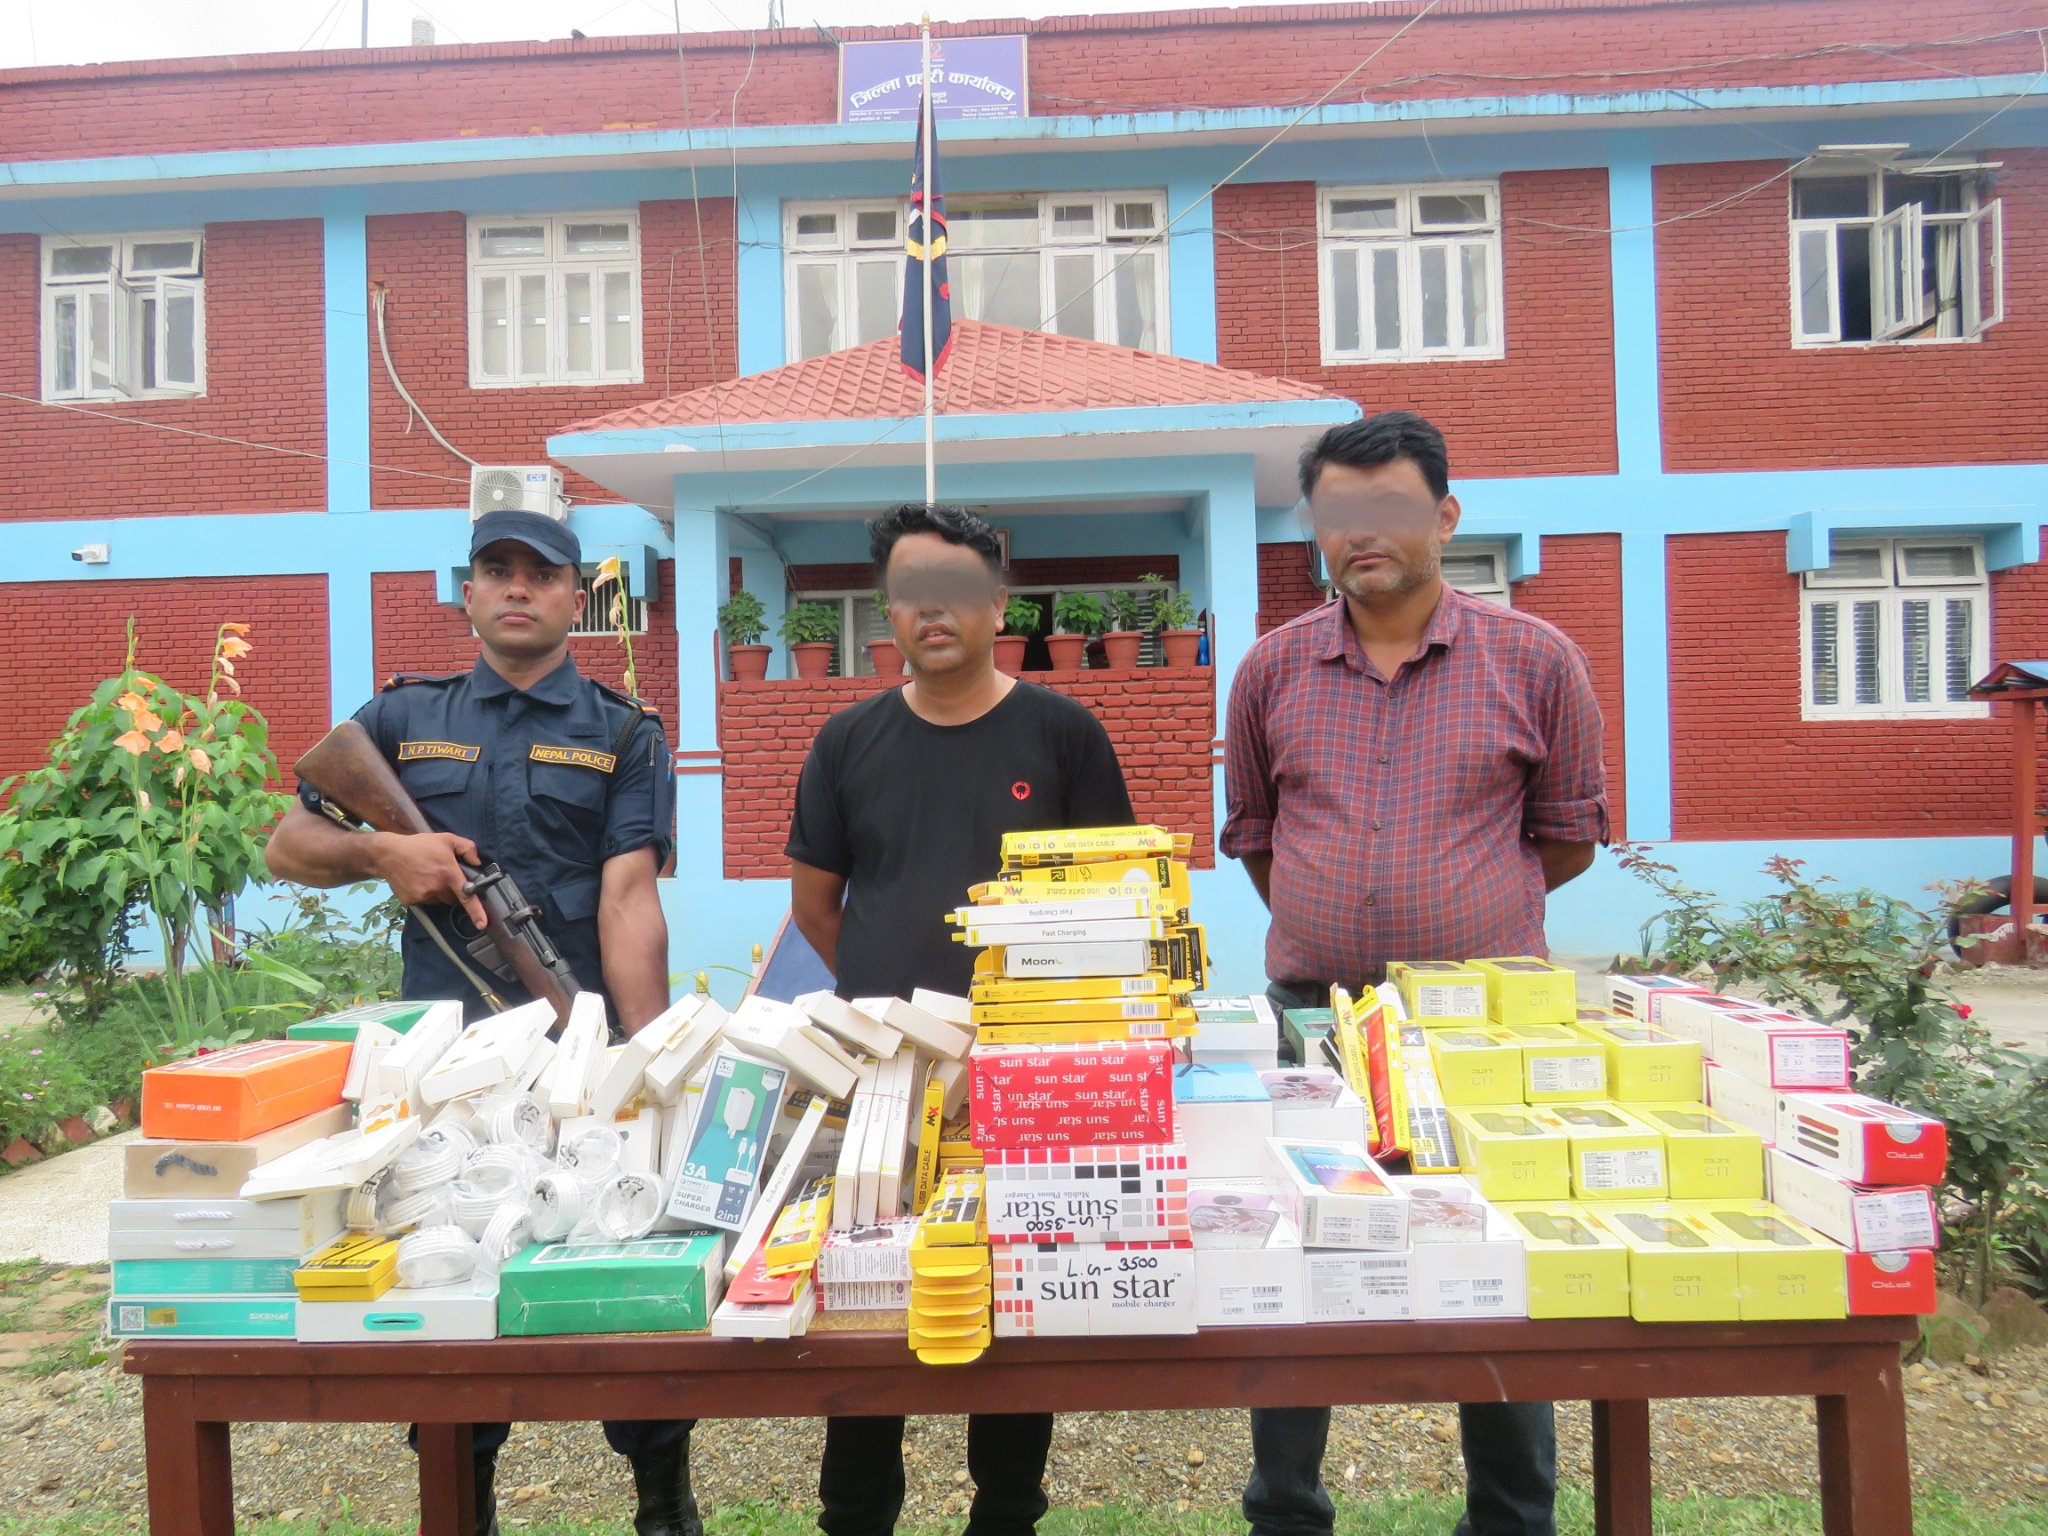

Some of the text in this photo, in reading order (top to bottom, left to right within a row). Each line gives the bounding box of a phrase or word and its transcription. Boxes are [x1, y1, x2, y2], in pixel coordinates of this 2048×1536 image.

[850, 77, 900, 108] जिल्ला
[948, 72, 1016, 102] कार्यालय
[534, 748, 611, 767] NEPAL POLICE
[1029, 909, 1058, 917] Charging
[1057, 929, 1087, 937] Charging
[1021, 957, 1055, 966] Moon
[999, 1056, 1050, 1068] sun star
[1074, 1055, 1125, 1066] sun star
[1034, 1073, 1085, 1084] sun star
[1109, 1073, 1132, 1082] sun
[976, 1076, 984, 1099] sun
[991, 1088, 1001, 1112] star
[1007, 1091, 1052, 1101] un star
[1075, 1089, 1126, 1100] sun star
[1045, 1100, 1068, 1108] sun
[1140, 1088, 1149, 1113] star
[1157, 1099, 1165, 1123] sun
[1012, 1117, 1035, 1125] sun
[1059, 1115, 1110, 1126] sun star
[1019, 1132, 1070, 1143] sun star
[1093, 1130, 1144, 1140] sun star
[684, 1162, 707, 1180] 3A
[918, 1150, 932, 1204] USB DATA CABLE
[677, 1191, 702, 1202] SUPER
[1004, 1191, 1035, 1199] Charger
[1037, 1191, 1060, 1199] Phone
[674, 1199, 711, 1213] CHARGER
[1002, 1199, 1118, 1221] sun star
[716, 1209, 739, 1223] 2in1
[1040, 1274, 1176, 1301] sun star
[1112, 1300, 1177, 1308] mobile charger
